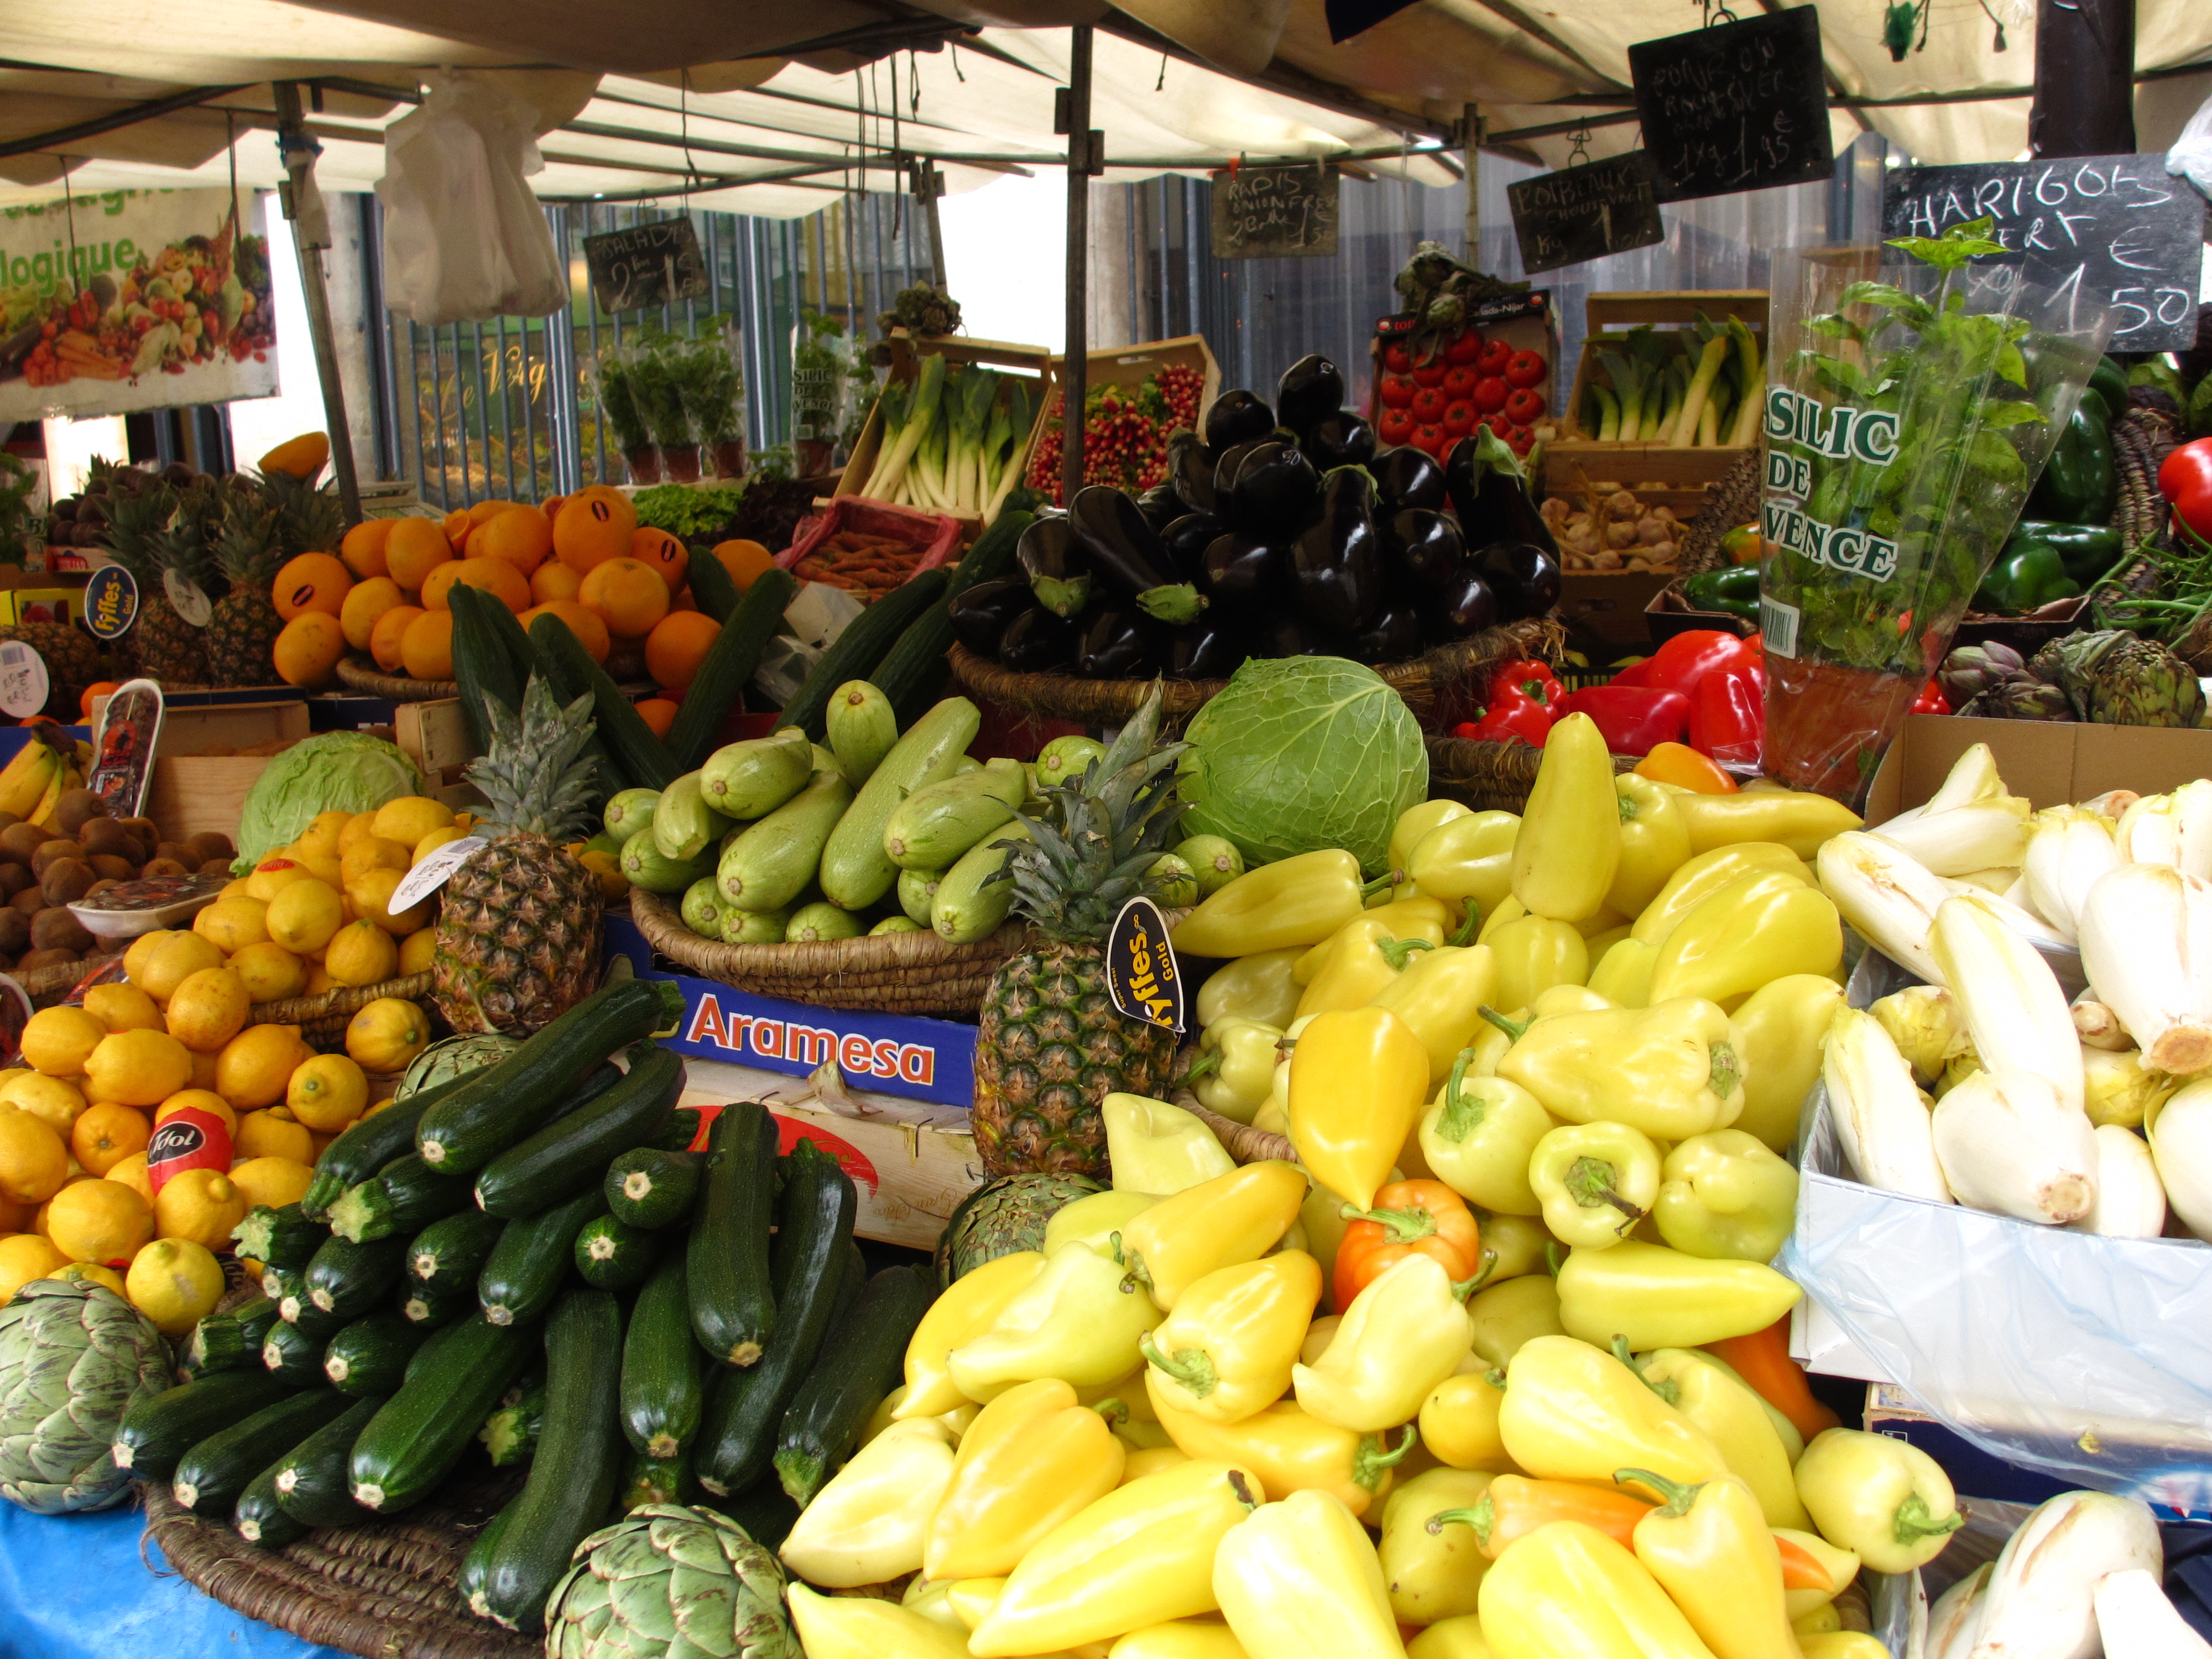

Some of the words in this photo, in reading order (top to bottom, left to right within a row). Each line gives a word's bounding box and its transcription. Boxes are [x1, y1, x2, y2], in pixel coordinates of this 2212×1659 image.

[2108, 226, 2165, 271] €
[1767, 449, 1812, 501] DE
[1155, 941, 1174, 981] Gold
[685, 992, 935, 1086] Aramesa
